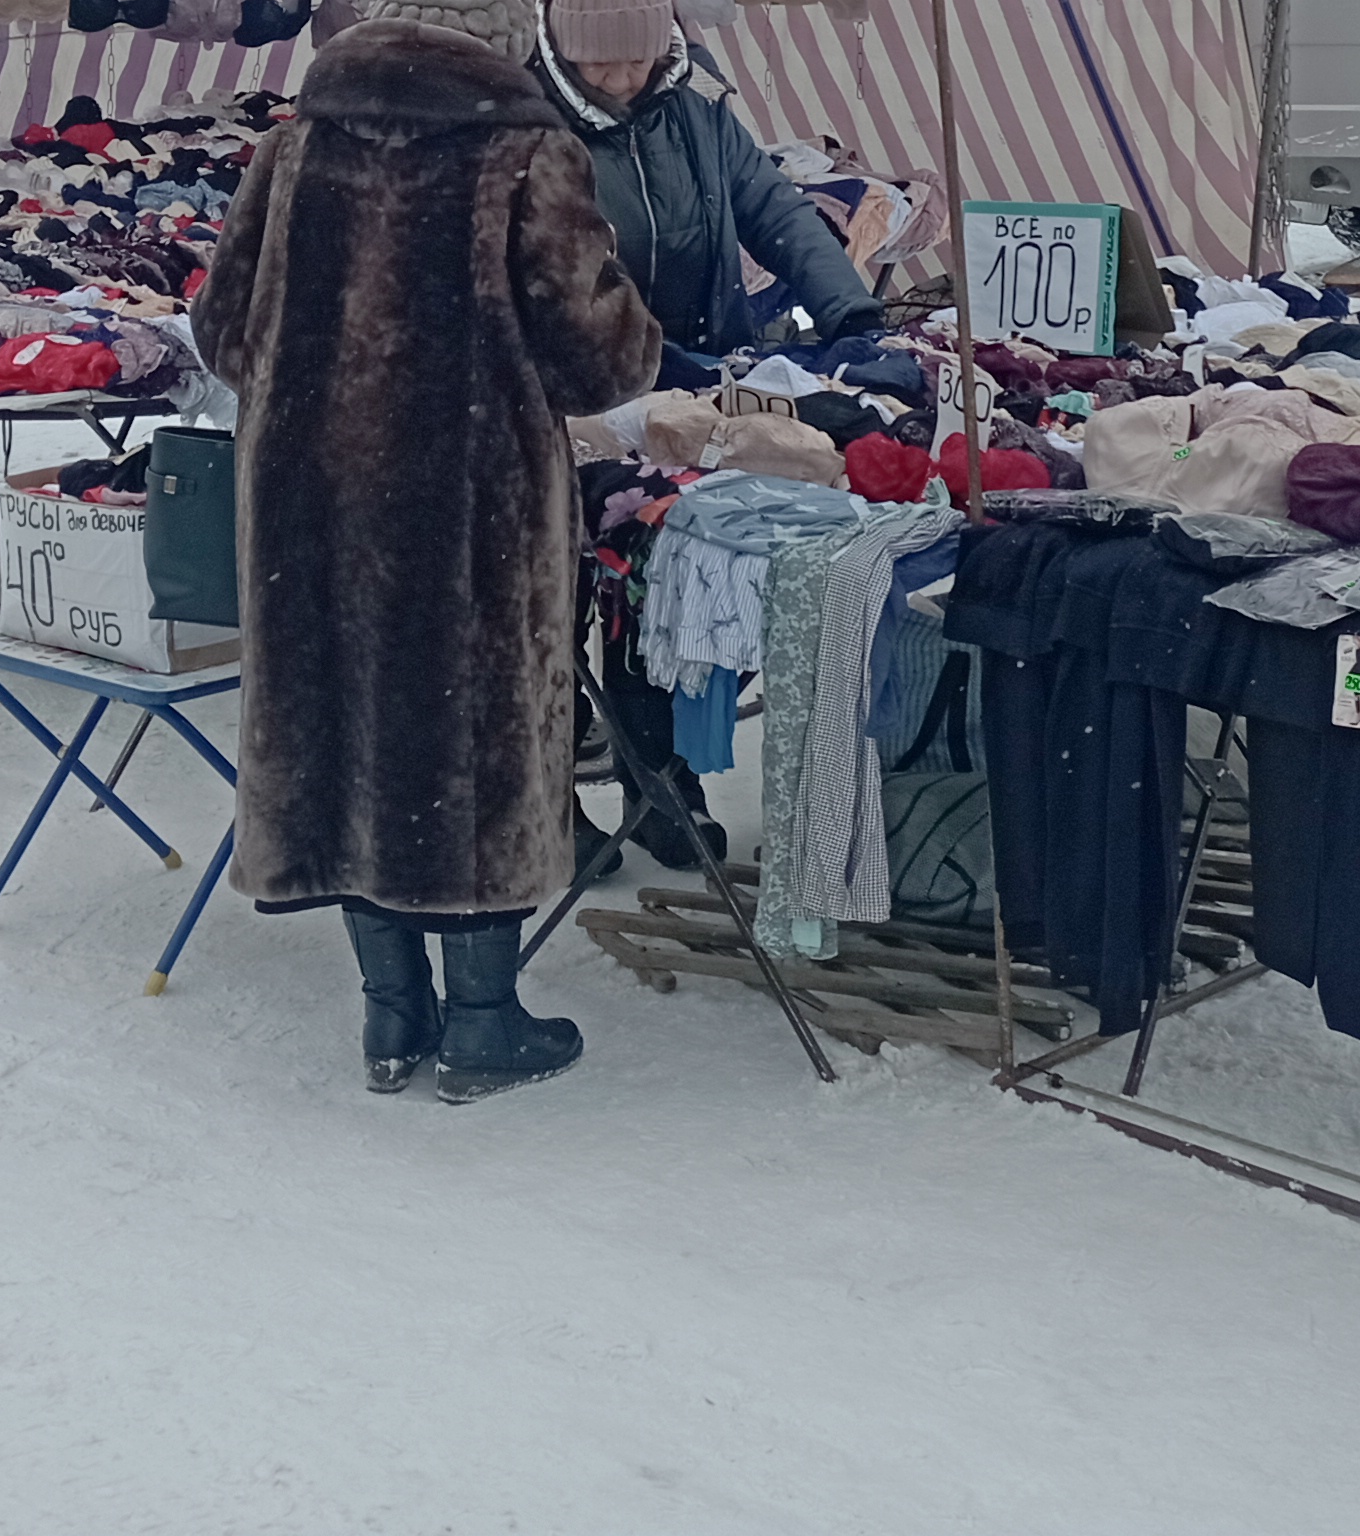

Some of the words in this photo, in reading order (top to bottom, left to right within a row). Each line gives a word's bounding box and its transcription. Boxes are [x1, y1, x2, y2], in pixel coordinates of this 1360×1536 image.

[1053, 224, 1076, 240] по
[90, 508, 146, 533] девоче
[42, 540, 65, 561] по
